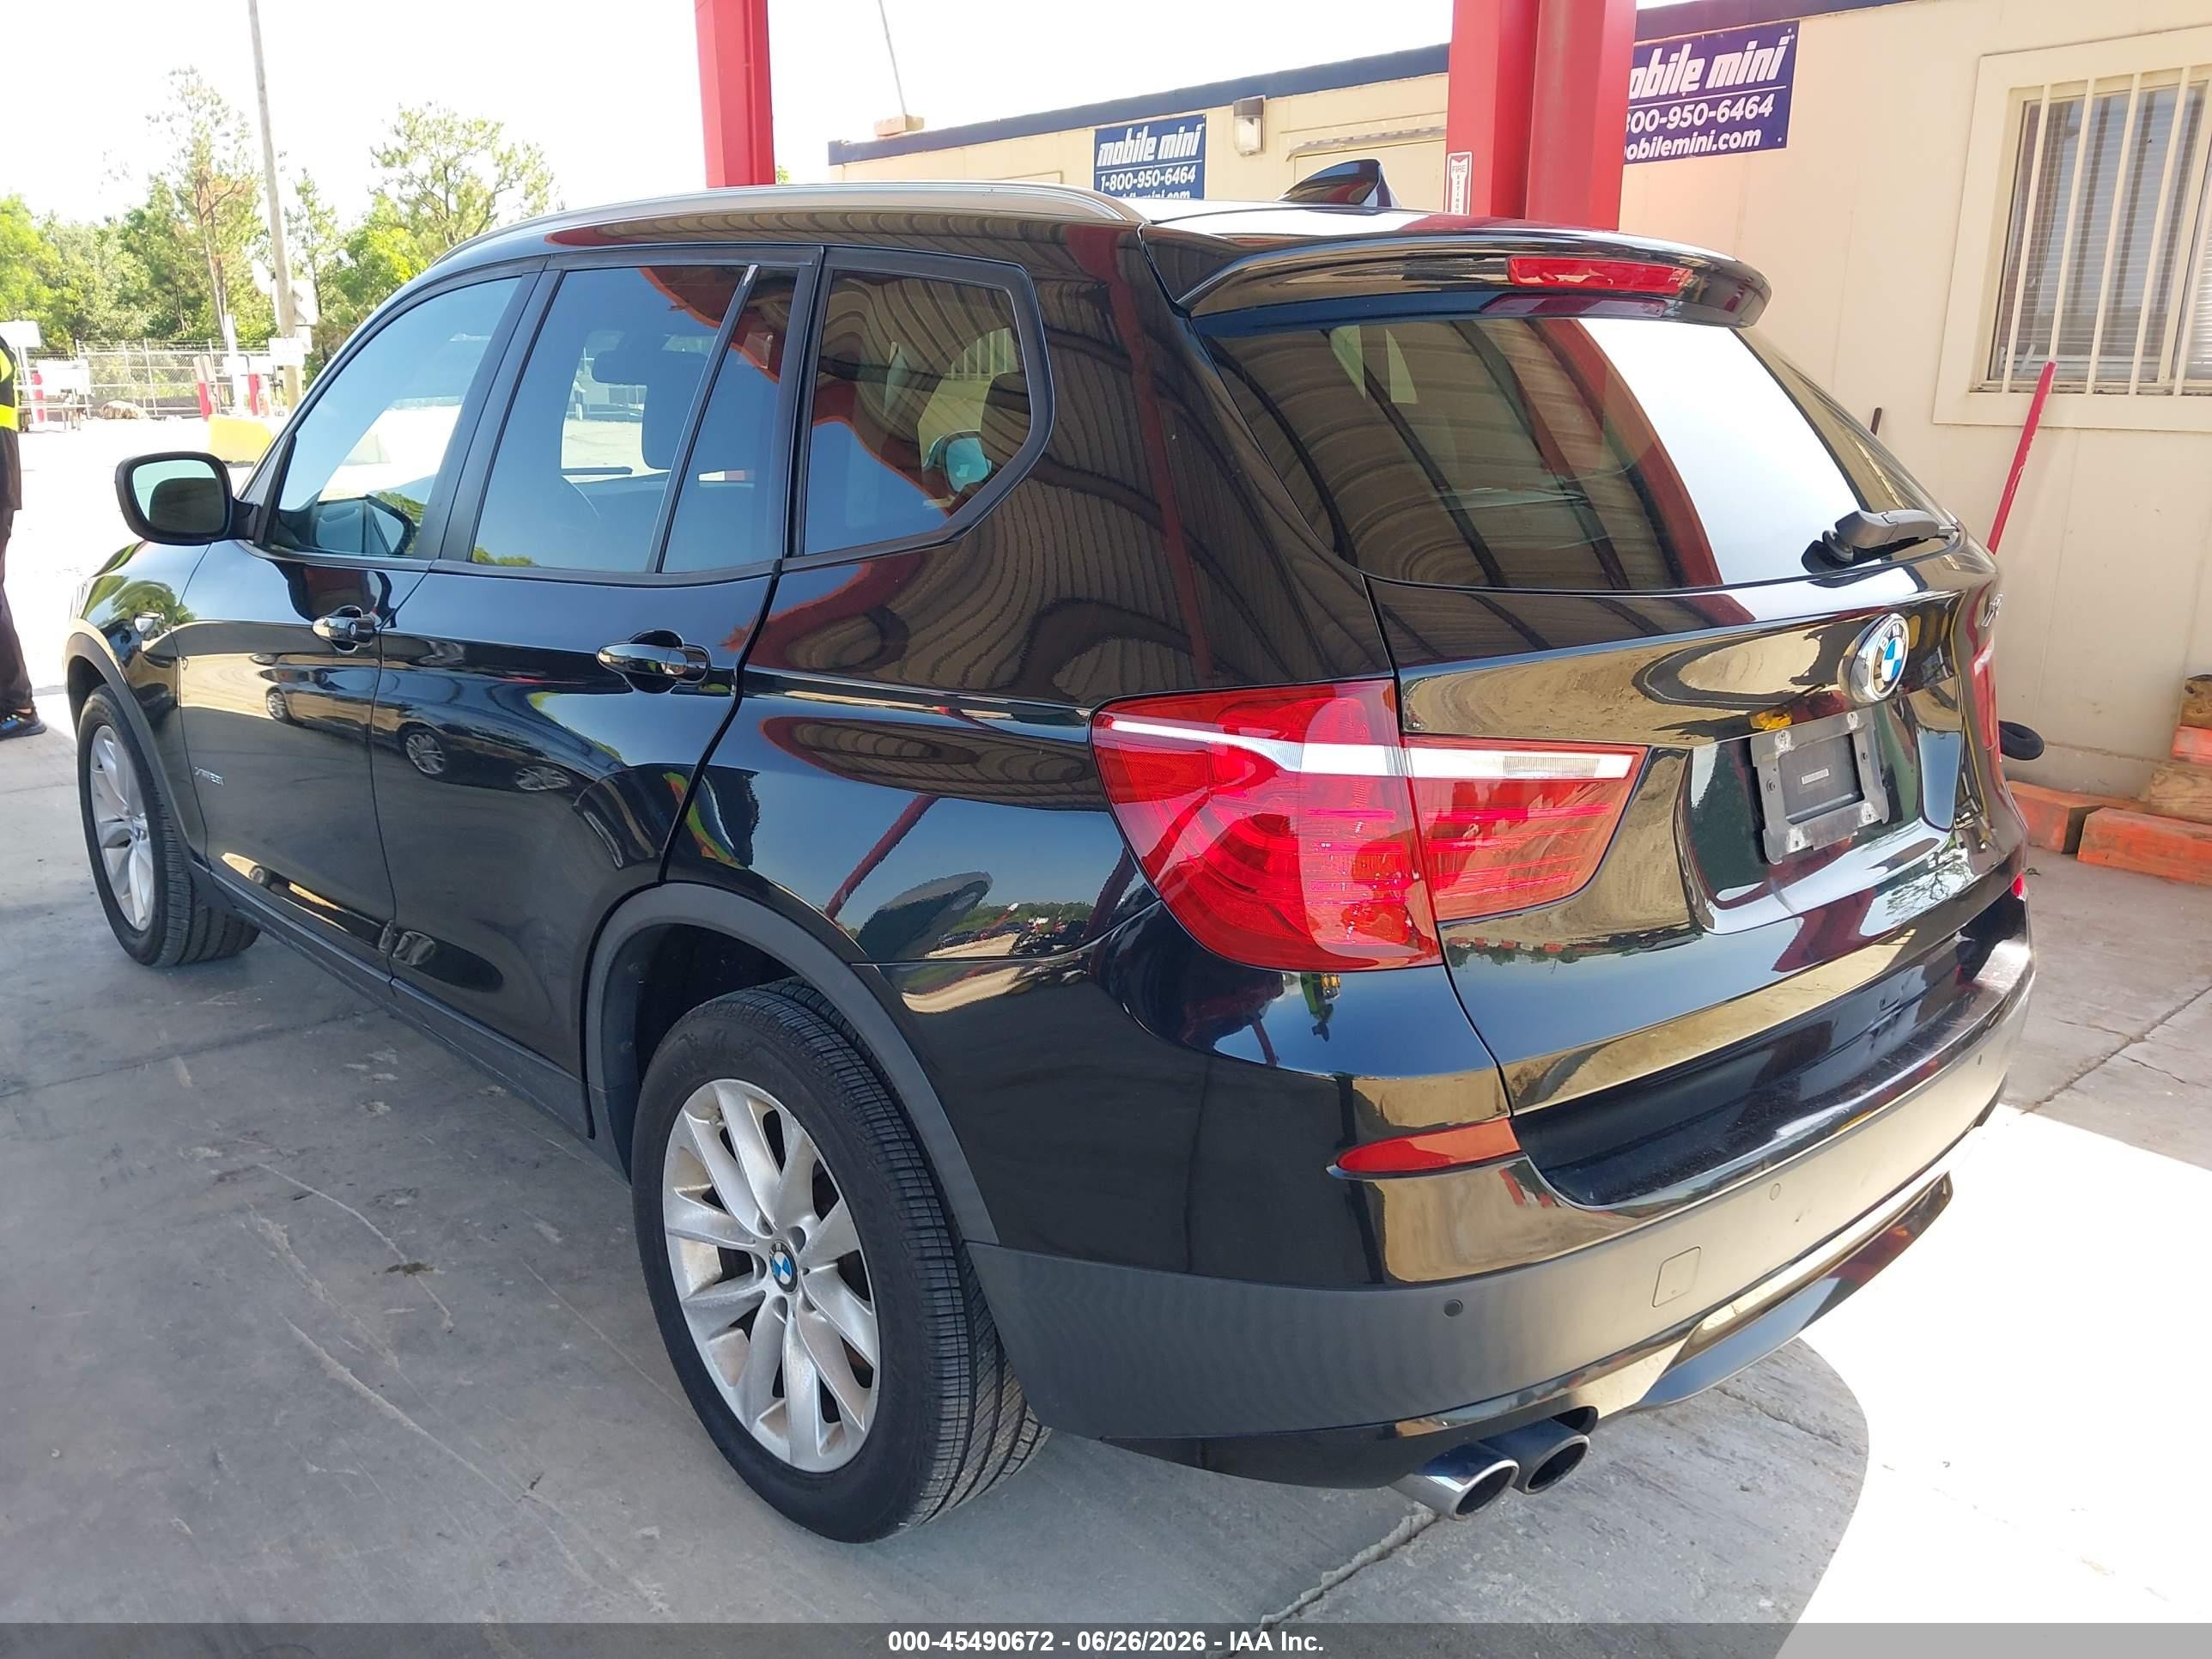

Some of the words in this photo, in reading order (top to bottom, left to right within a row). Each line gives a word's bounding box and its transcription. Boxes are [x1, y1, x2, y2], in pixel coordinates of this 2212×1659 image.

[1629, 43, 1705, 100] obile
[1705, 36, 1790, 89] mini
[1097, 125, 1157, 167] mobile
[1158, 123, 1202, 160] mini
[1625, 129, 1762, 161] obilemini.com
[1101, 165, 1196, 191] 1-800-950-6464
